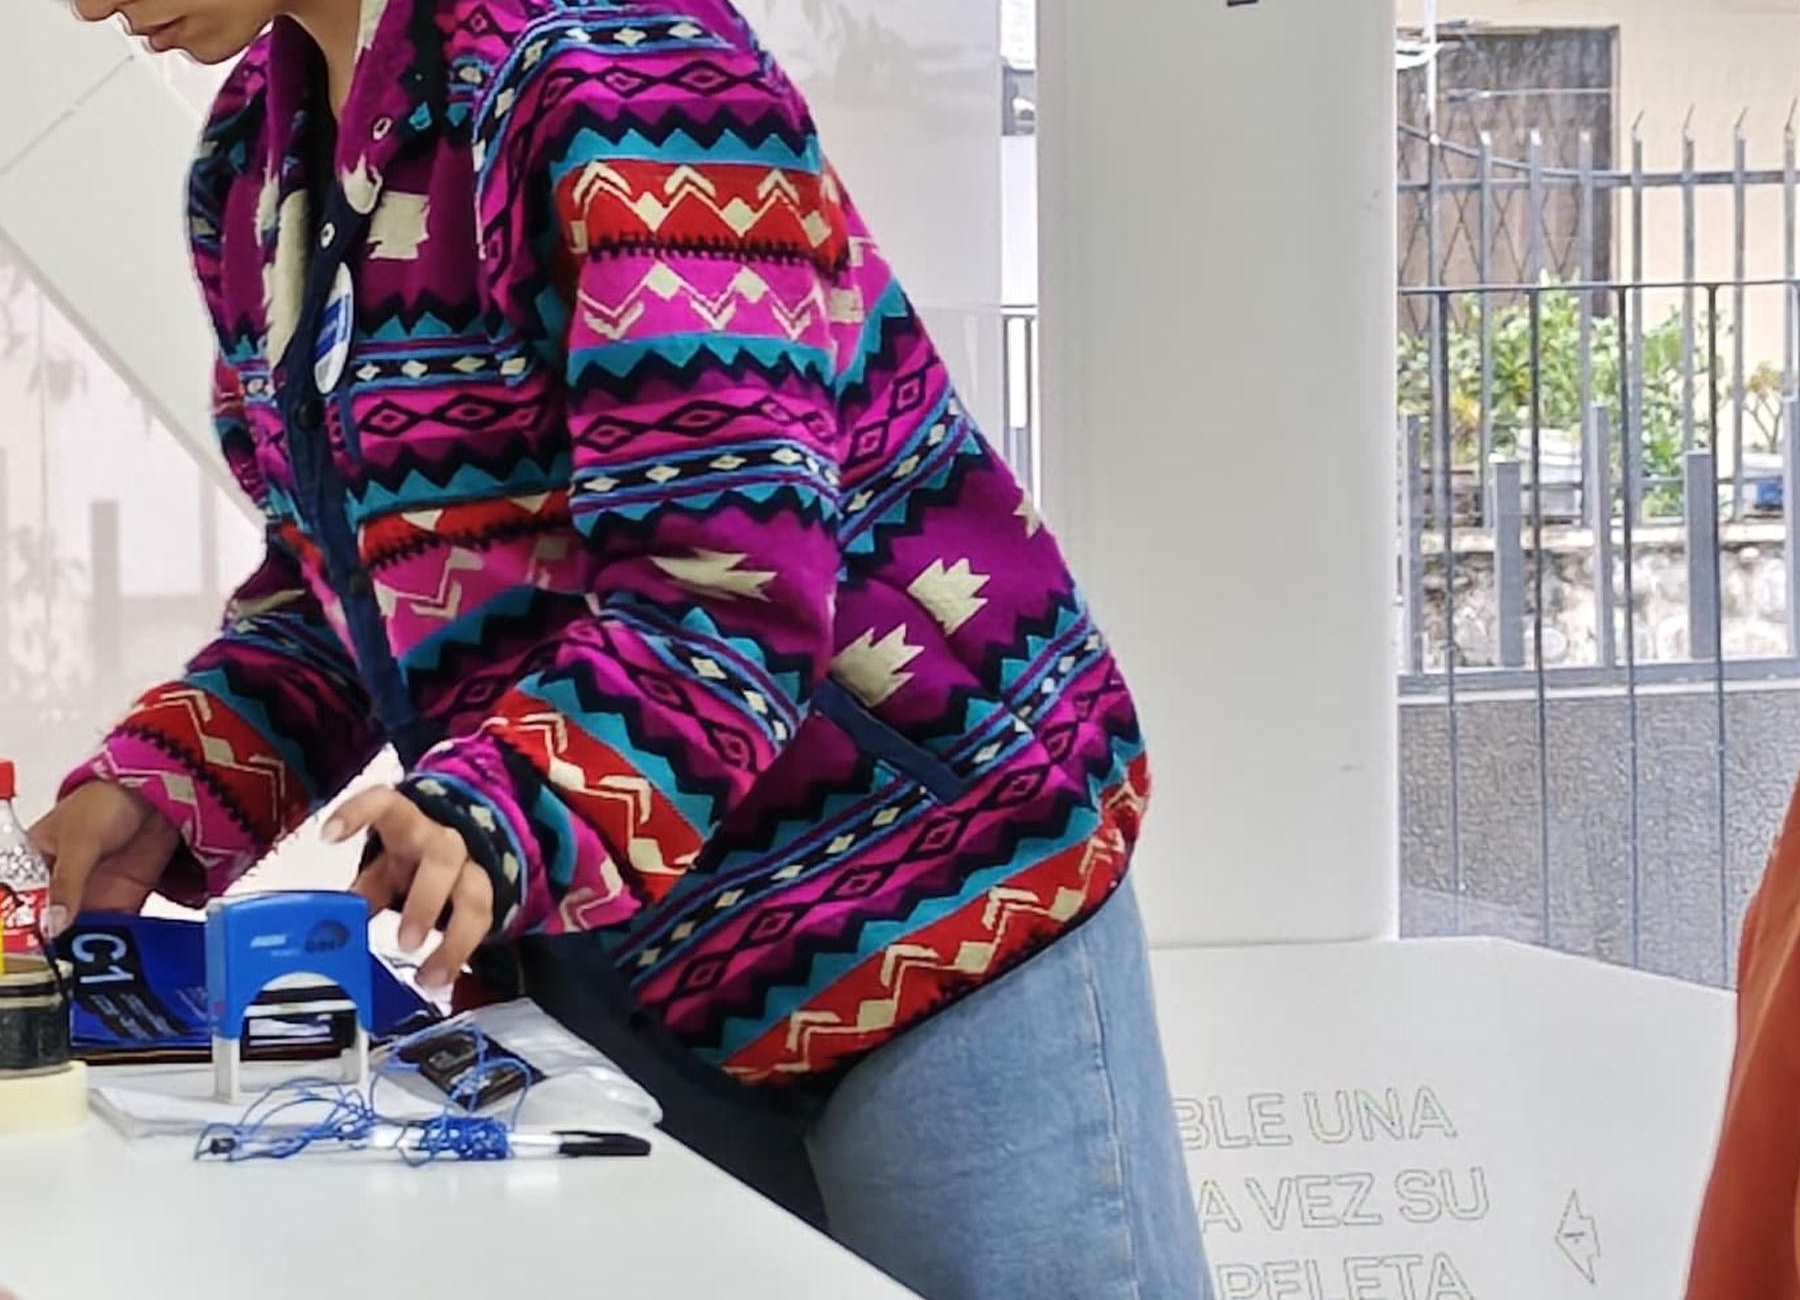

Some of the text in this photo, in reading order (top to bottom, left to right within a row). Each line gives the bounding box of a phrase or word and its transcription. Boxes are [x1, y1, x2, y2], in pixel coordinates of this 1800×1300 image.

[71, 932, 135, 984] C1
[1171, 1086, 1458, 1150] BLE UNA
[1245, 1172, 1384, 1232] VEZ
[1394, 1165, 1490, 1224] SU
